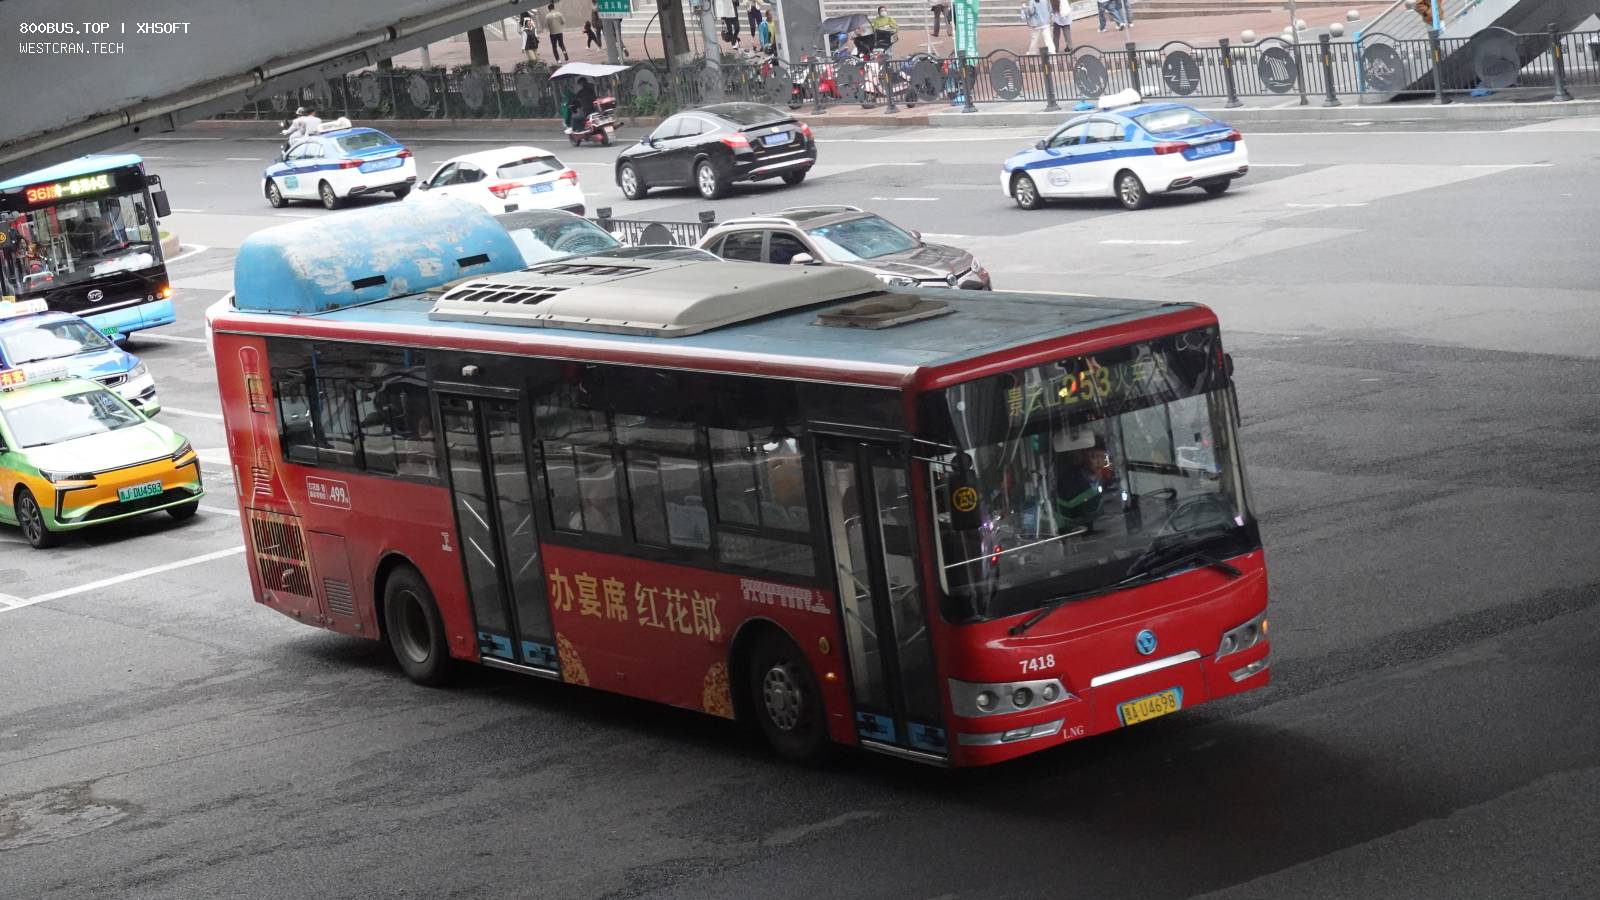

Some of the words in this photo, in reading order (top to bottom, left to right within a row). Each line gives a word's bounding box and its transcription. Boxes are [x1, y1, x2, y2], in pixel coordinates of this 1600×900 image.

[1, 370, 24, 385] 有客
[1062, 366, 1112, 404] 253
[550, 567, 628, 622] 办宴席
[634, 581, 721, 641] 红花郎
[1019, 654, 1055, 674] 7418
[1063, 725, 1084, 740] LNG
